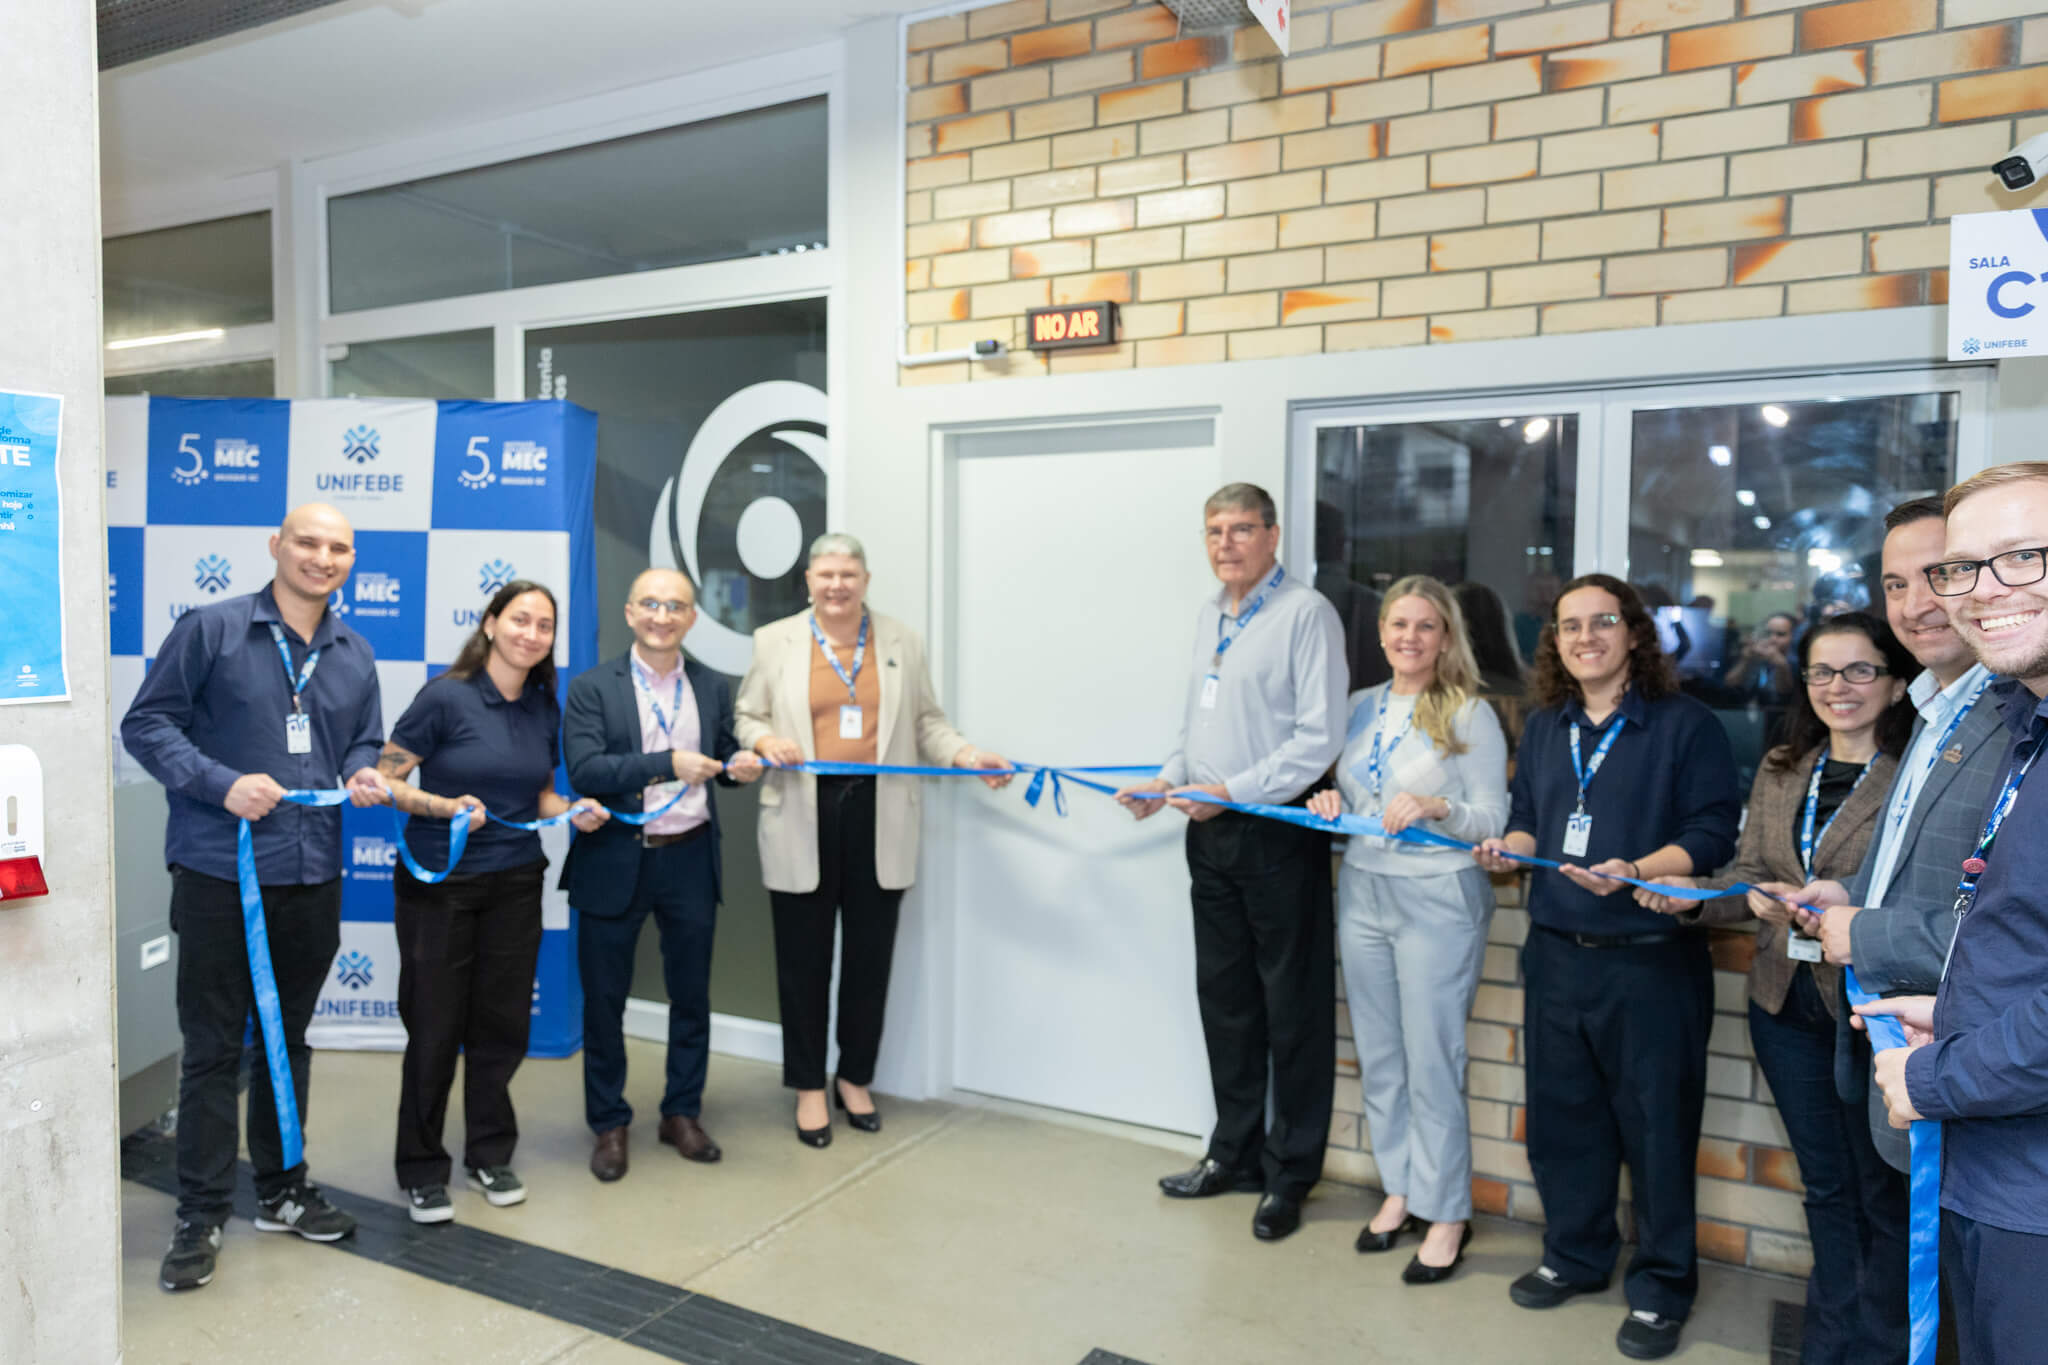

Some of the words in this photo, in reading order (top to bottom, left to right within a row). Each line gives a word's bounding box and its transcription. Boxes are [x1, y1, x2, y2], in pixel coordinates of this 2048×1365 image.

[1969, 255, 2010, 269] SALA
[1986, 271, 2048, 319] C
[1034, 313, 1067, 342] NO
[1067, 309, 1100, 338] AR
[1983, 339, 2029, 349] UNIFEBE
[214, 449, 260, 468] MEC
[502, 451, 547, 471] MEC
[316, 473, 404, 492] UNIFEBE
[355, 583, 400, 602] MEC
[353, 847, 398, 866] MEC
